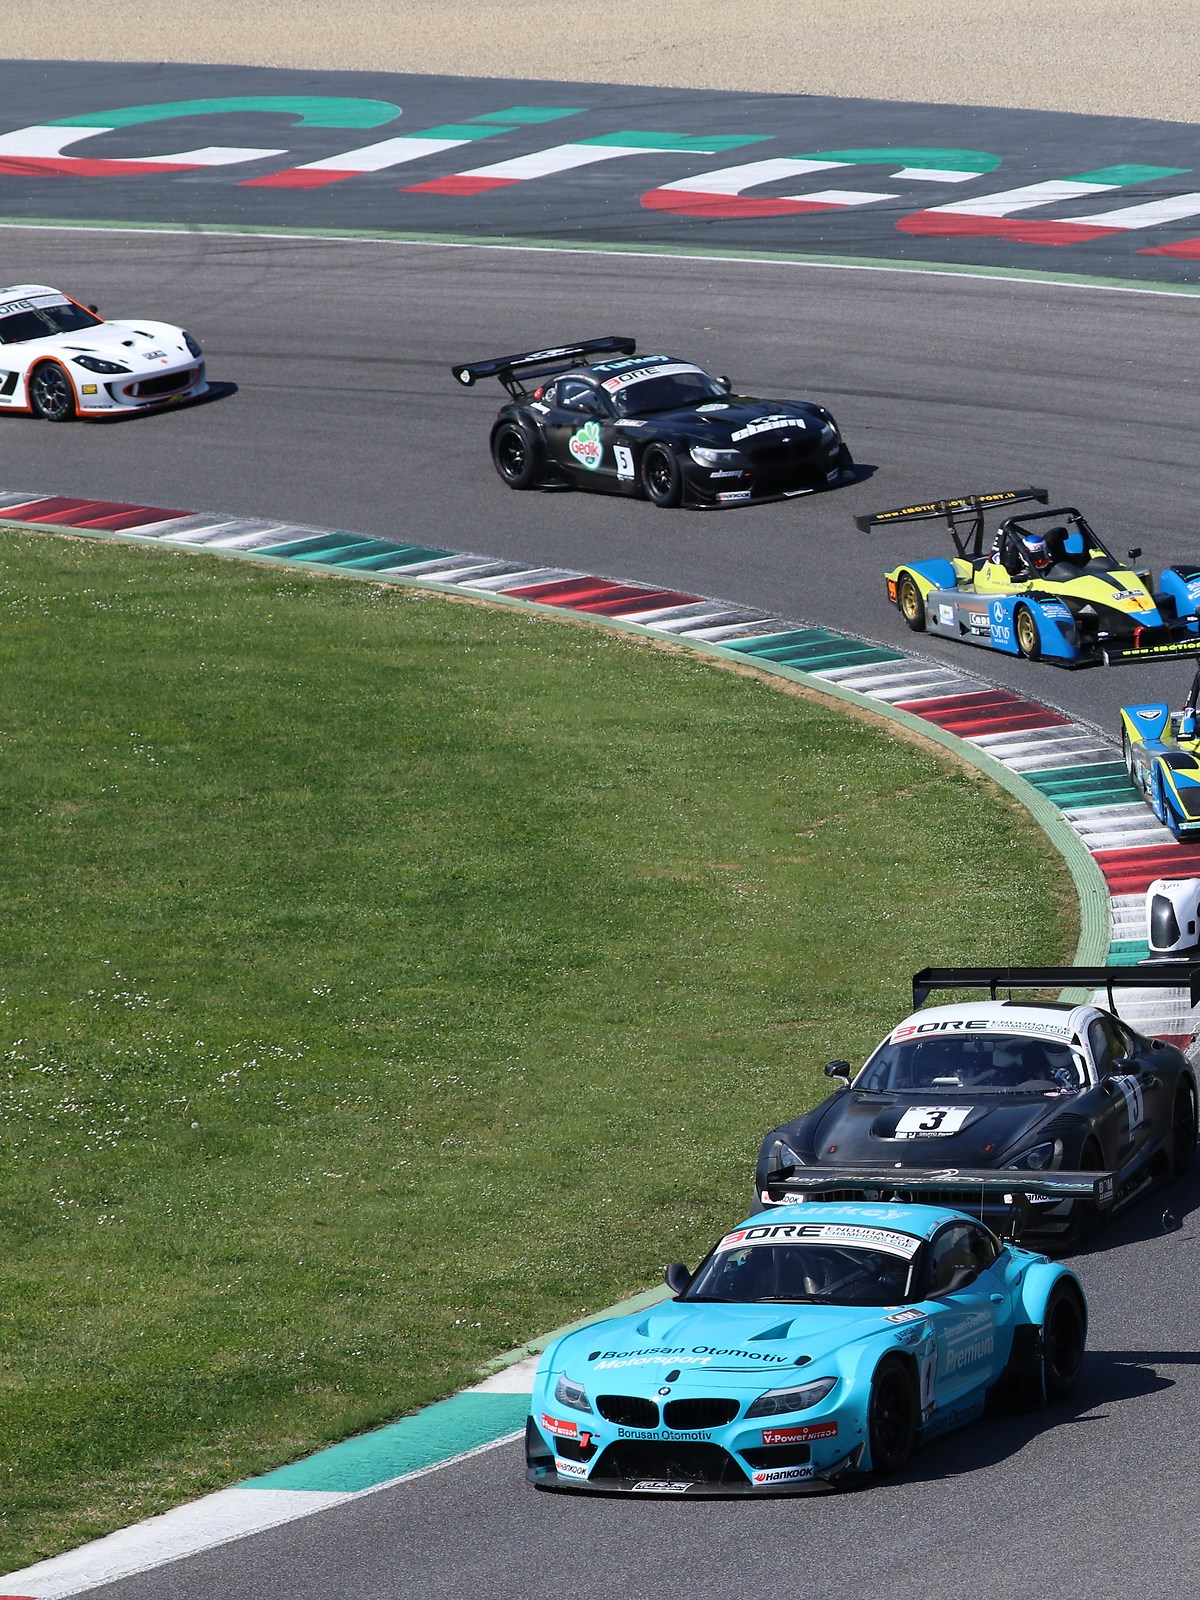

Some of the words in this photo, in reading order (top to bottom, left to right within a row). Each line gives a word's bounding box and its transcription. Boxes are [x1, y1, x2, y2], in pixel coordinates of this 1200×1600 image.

[0, 299, 34, 315] ORE
[571, 440, 599, 456] Gedik
[619, 451, 628, 469] 5
[991, 1020, 1071, 1031] ENDURANCE
[1123, 1079, 1139, 1121] 3
[919, 1111, 948, 1130] 3
[825, 1231, 888, 1243] CHAMPIONS
[888, 1239, 913, 1249] CUP
[827, 1226, 915, 1244] ENDURANCE
[593, 1355, 712, 1371] Motorsport
[601, 1346, 686, 1359] Borusan
[691, 1345, 790, 1363] Otomotiv
[946, 1336, 994, 1373] Premium
[925, 1361, 932, 1396] 1
[617, 1427, 660, 1440] Borusan
[661, 1430, 712, 1441] Otomotiv
[763, 1433, 807, 1443] V-Power
